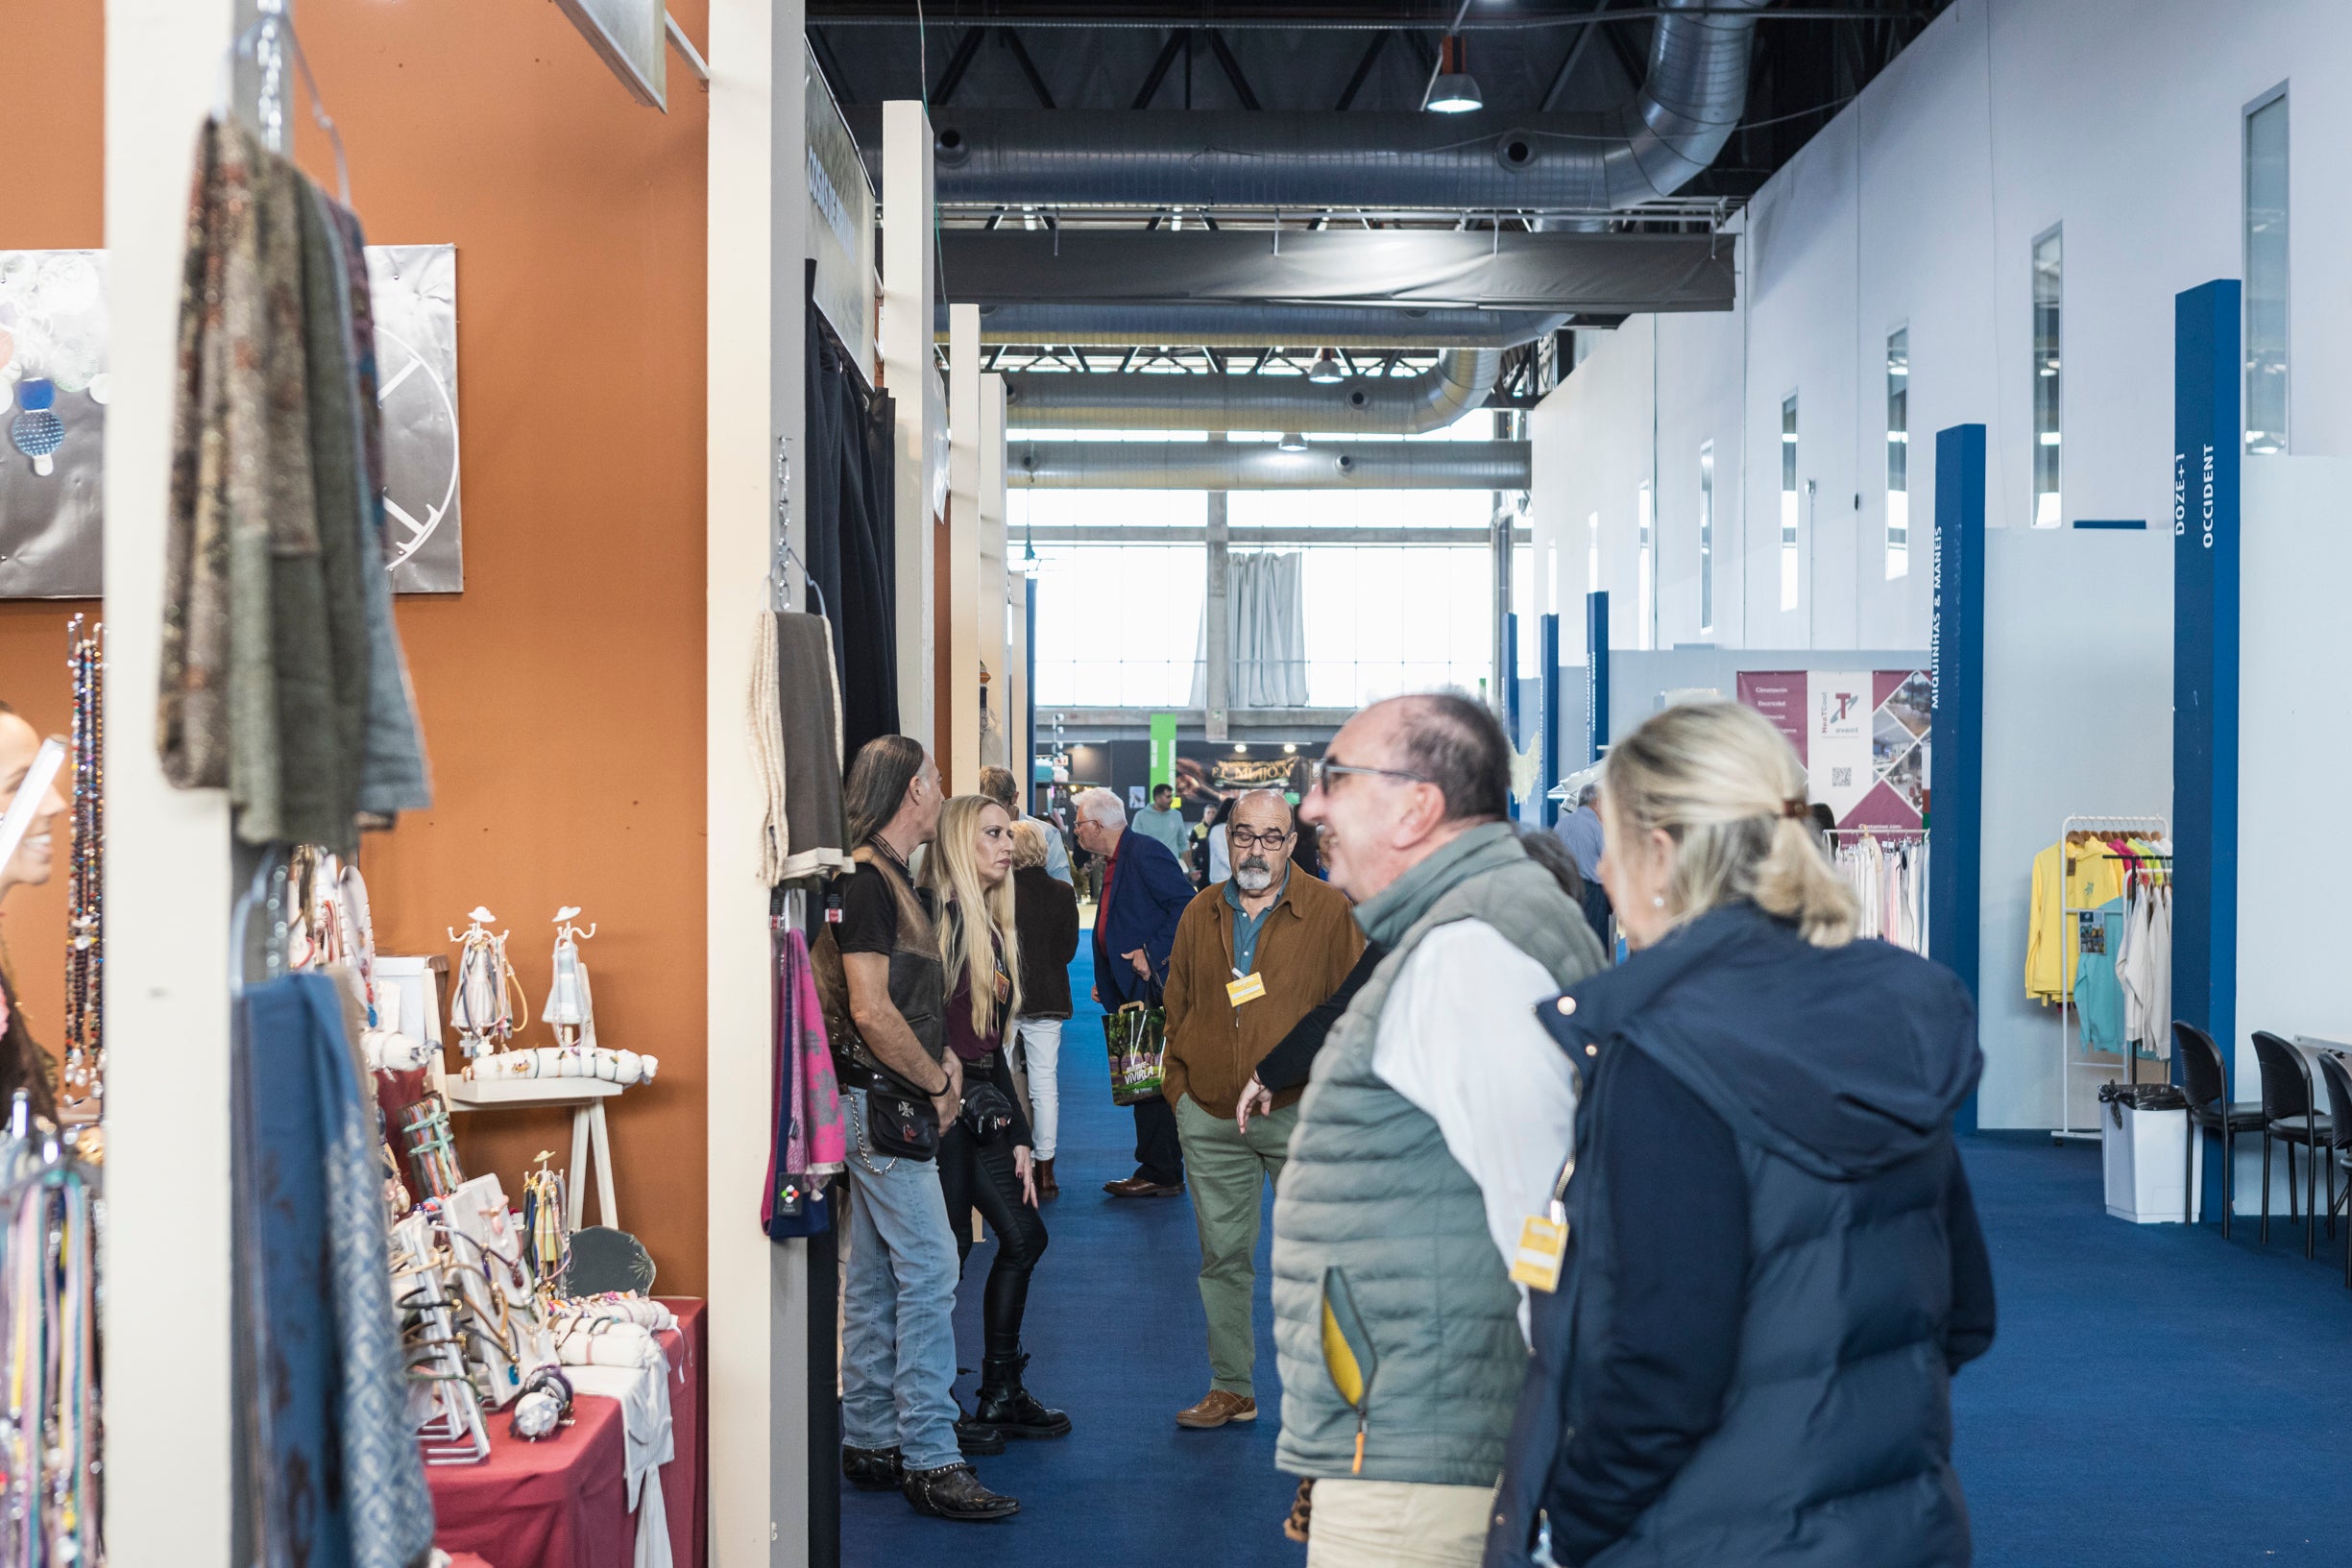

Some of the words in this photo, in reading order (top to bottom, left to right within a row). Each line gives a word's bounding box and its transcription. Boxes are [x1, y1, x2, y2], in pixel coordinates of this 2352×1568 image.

[2175, 453, 2185, 536] DOZE+1
[2203, 444, 2214, 548] OCCIDENT
[1934, 595, 1940, 607] &
[1931, 612, 1941, 710] MIQUINHAS
